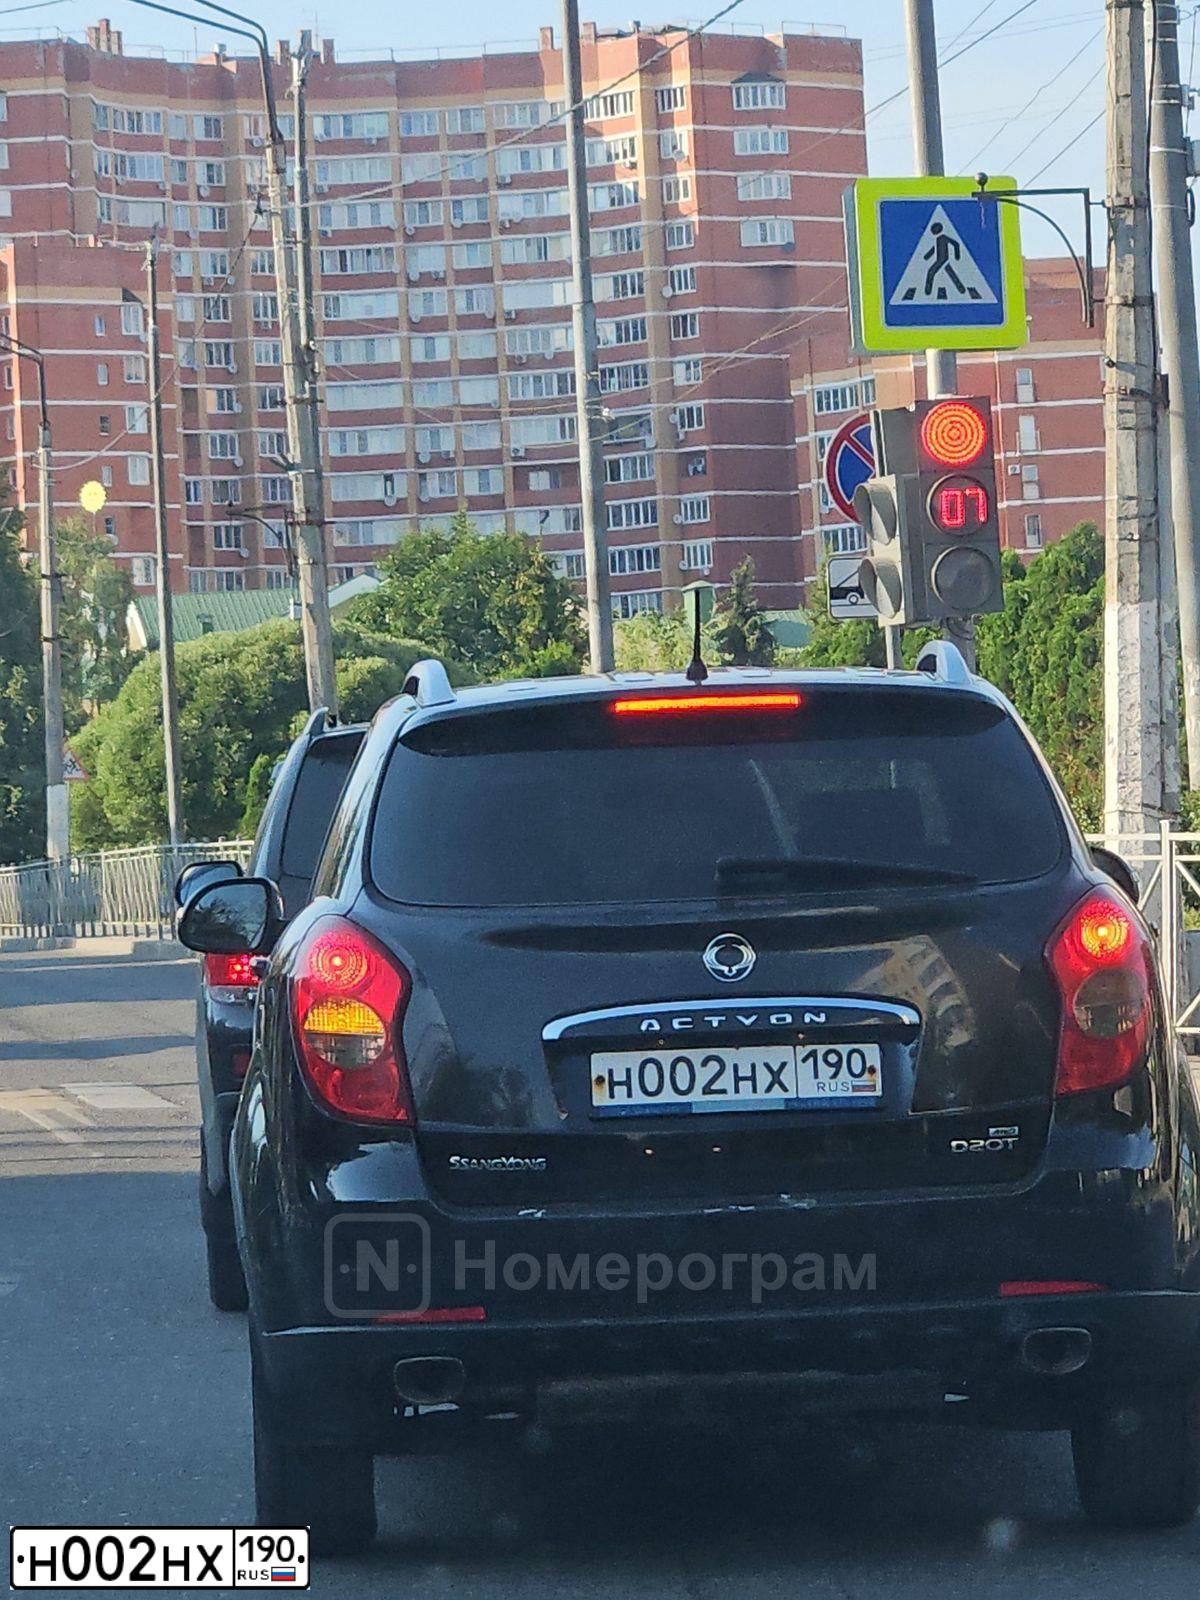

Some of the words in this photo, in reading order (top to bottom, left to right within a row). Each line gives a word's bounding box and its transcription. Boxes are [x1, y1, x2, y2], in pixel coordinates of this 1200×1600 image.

[941, 487, 987, 527] 07
[801, 1048, 867, 1080] 190
[816, 1081, 850, 1094] RUS
